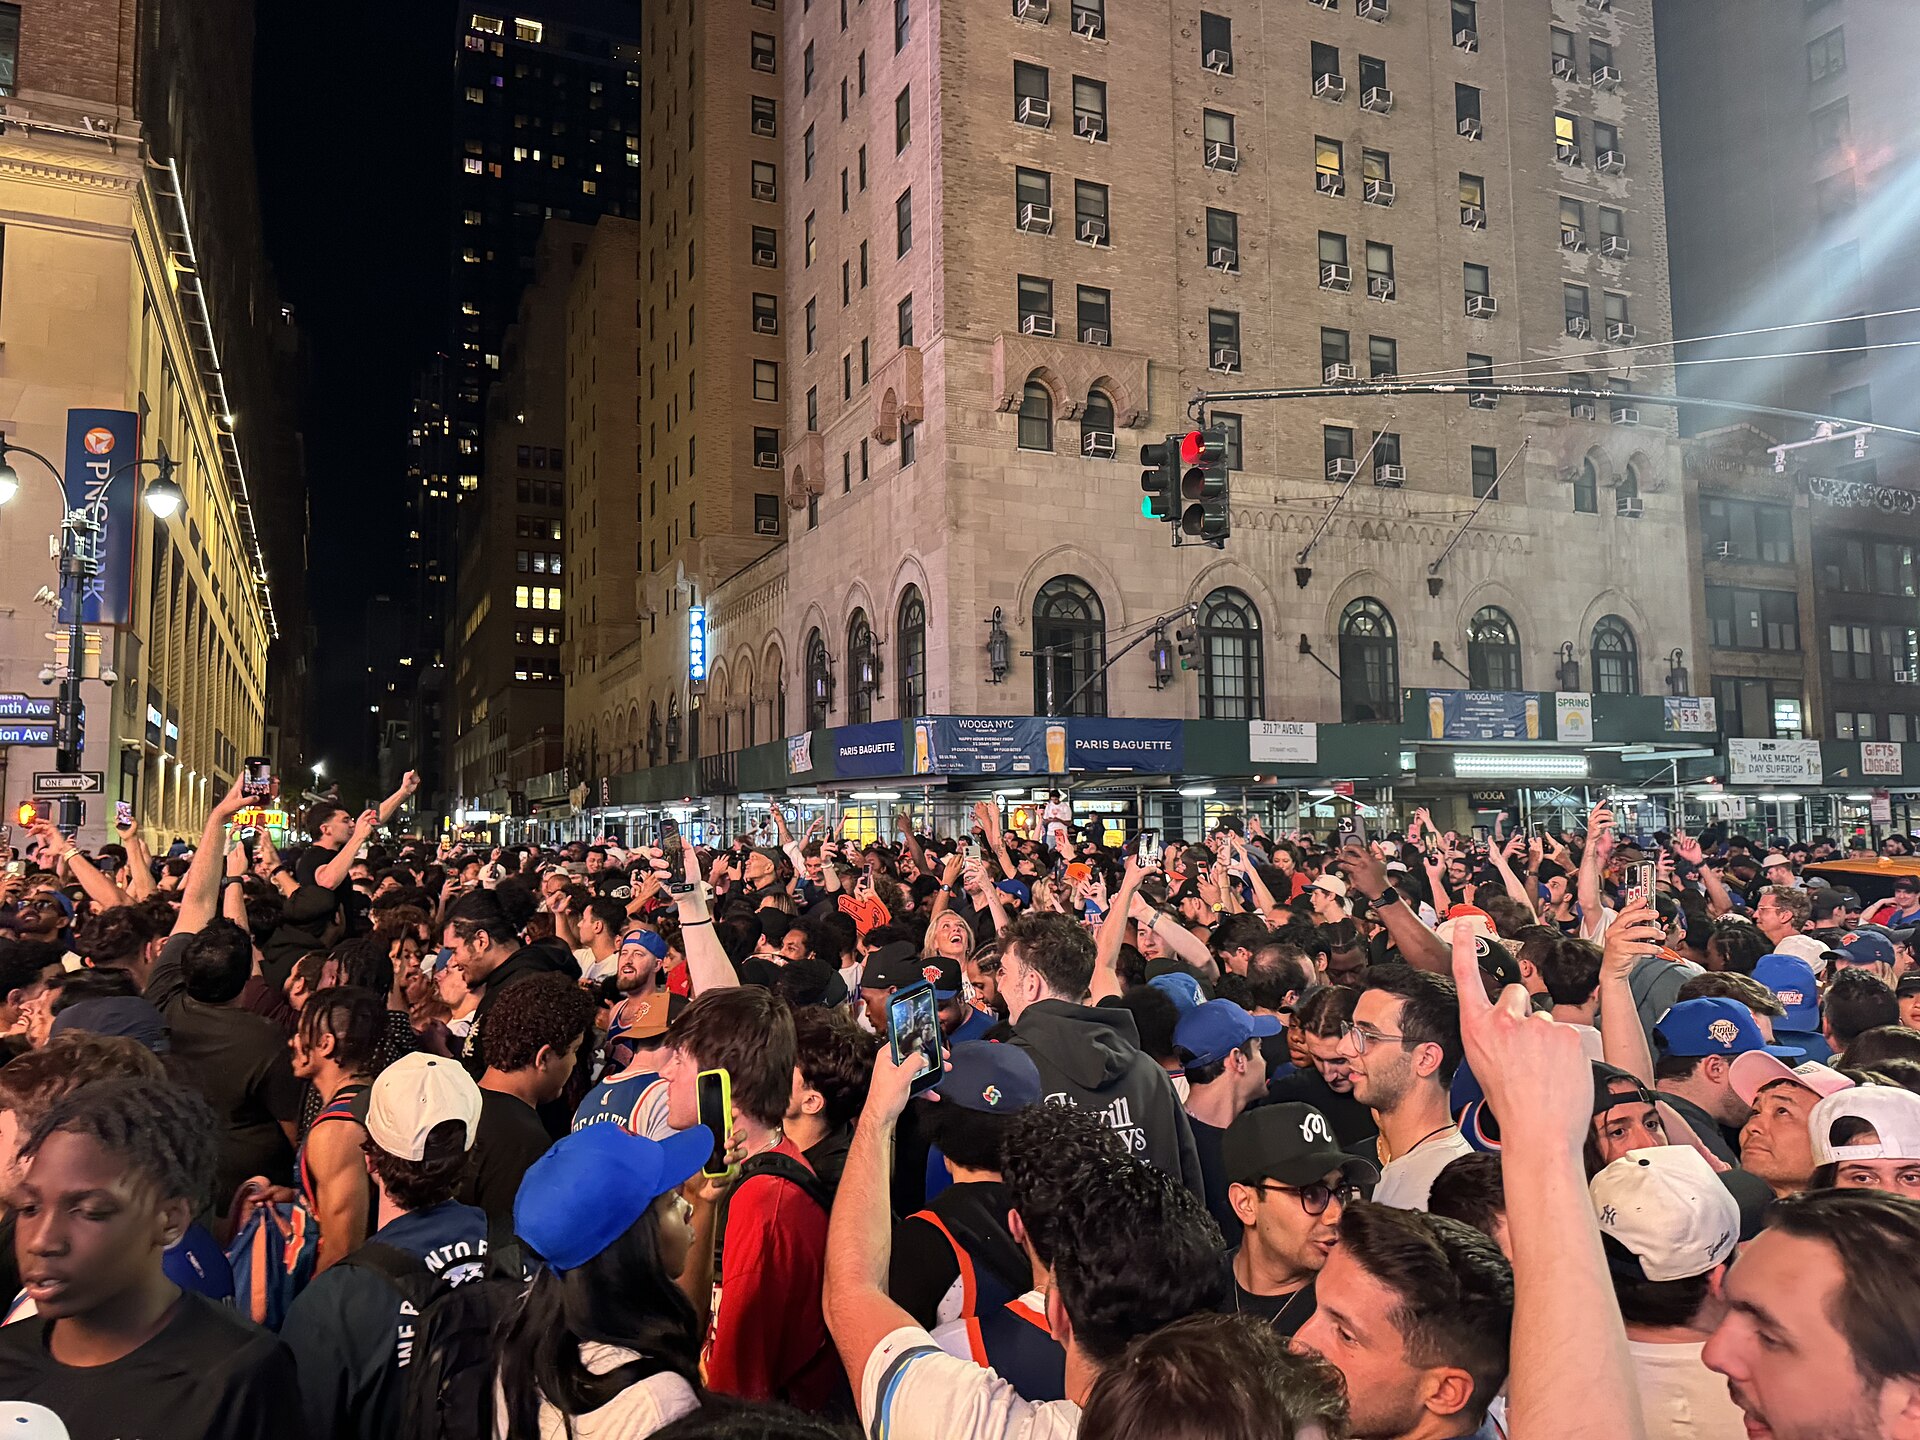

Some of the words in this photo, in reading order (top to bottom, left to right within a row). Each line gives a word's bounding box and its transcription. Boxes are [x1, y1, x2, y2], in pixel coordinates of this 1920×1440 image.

[690, 611, 703, 666] PARK
[1557, 698, 1590, 708] SPRING
[25, 703, 50, 714] Ave
[958, 719, 994, 729] WOOGA
[996, 720, 1014, 729] NYC
[1263, 723, 1273, 734] 371
[1281, 724, 1304, 735] AVENUE
[23, 728, 49, 740] Ave
[840, 746, 858, 756] PARIS
[859, 743, 896, 755] BAGUETTE
[1075, 740, 1110, 749] PARIS
[1112, 740, 1172, 750] BAGUETTE
[1865, 744, 1894, 756] GIFTS
[1750, 754, 1773, 763] MAKE
[1774, 754, 1801, 763] MATCH
[1749, 764, 1764, 773] DAY
[1765, 764, 1804, 774] SUPERIOR
[45, 779, 63, 787] ONE
[71, 779, 90, 787] WAY
[1472, 790, 1505, 800] WOOGA
[1684, 814, 1701, 822] OOGA
